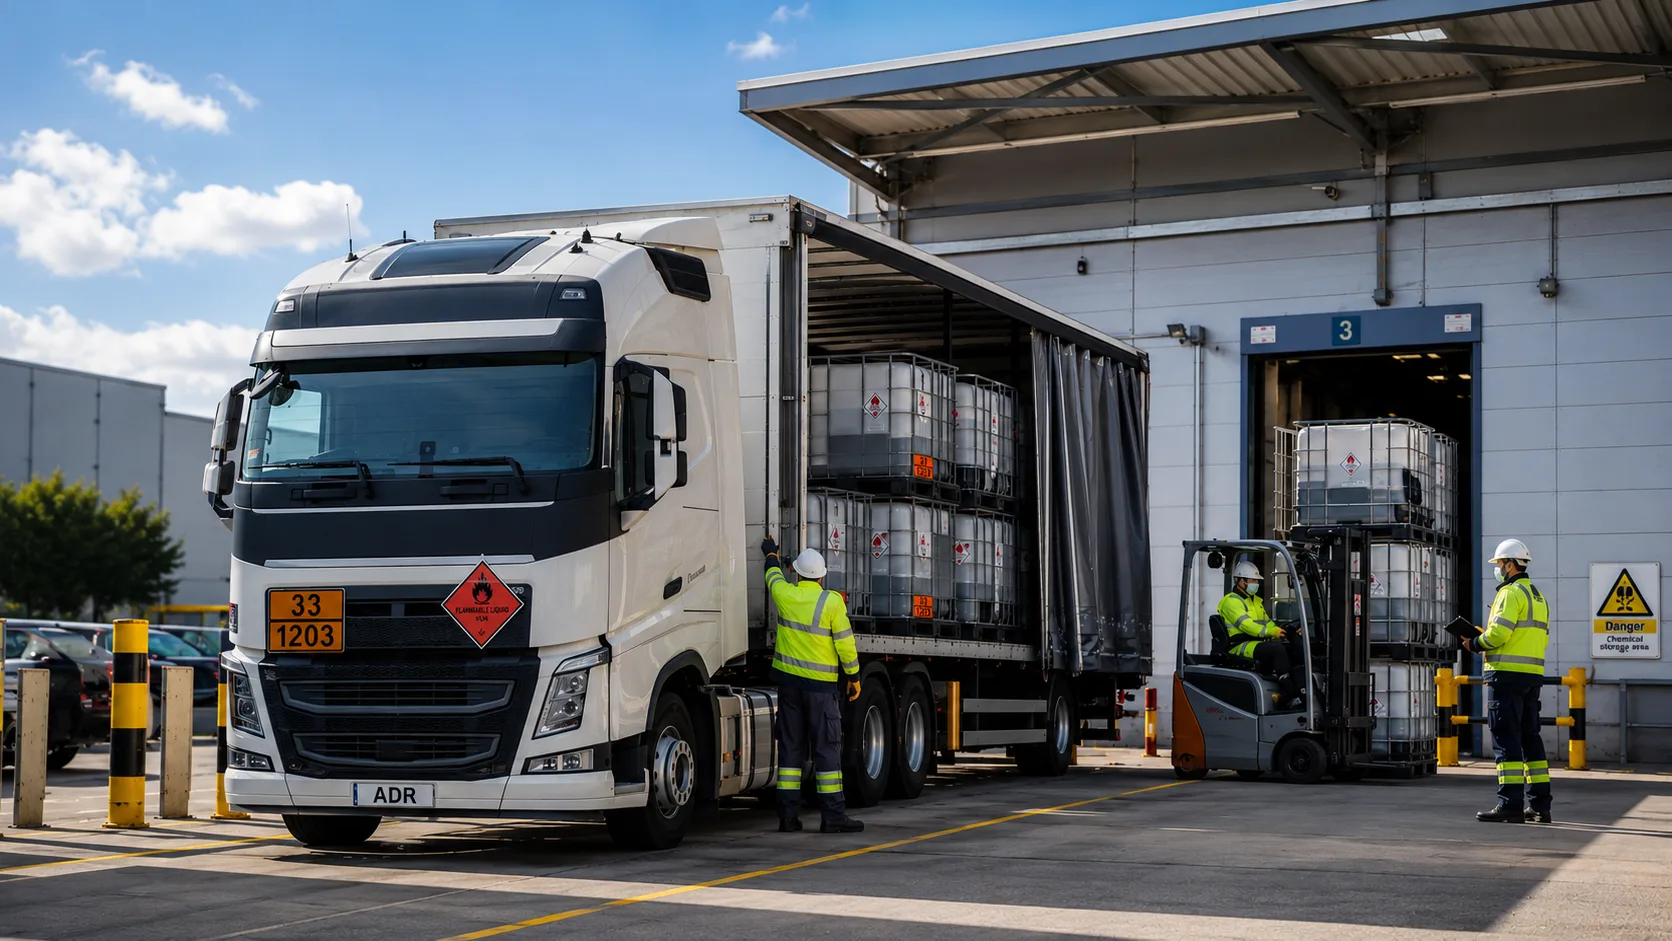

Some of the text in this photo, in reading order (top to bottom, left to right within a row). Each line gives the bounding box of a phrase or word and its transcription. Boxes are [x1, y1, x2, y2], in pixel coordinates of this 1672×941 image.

[1339, 320, 1353, 341] 3
[291, 593, 321, 617] 33
[276, 624, 335, 648] 1203
[1605, 621, 1646, 634] Danger
[1606, 635, 1644, 644] Chemical
[1600, 644, 1650, 654] storage area
[372, 786, 417, 804] ADR
